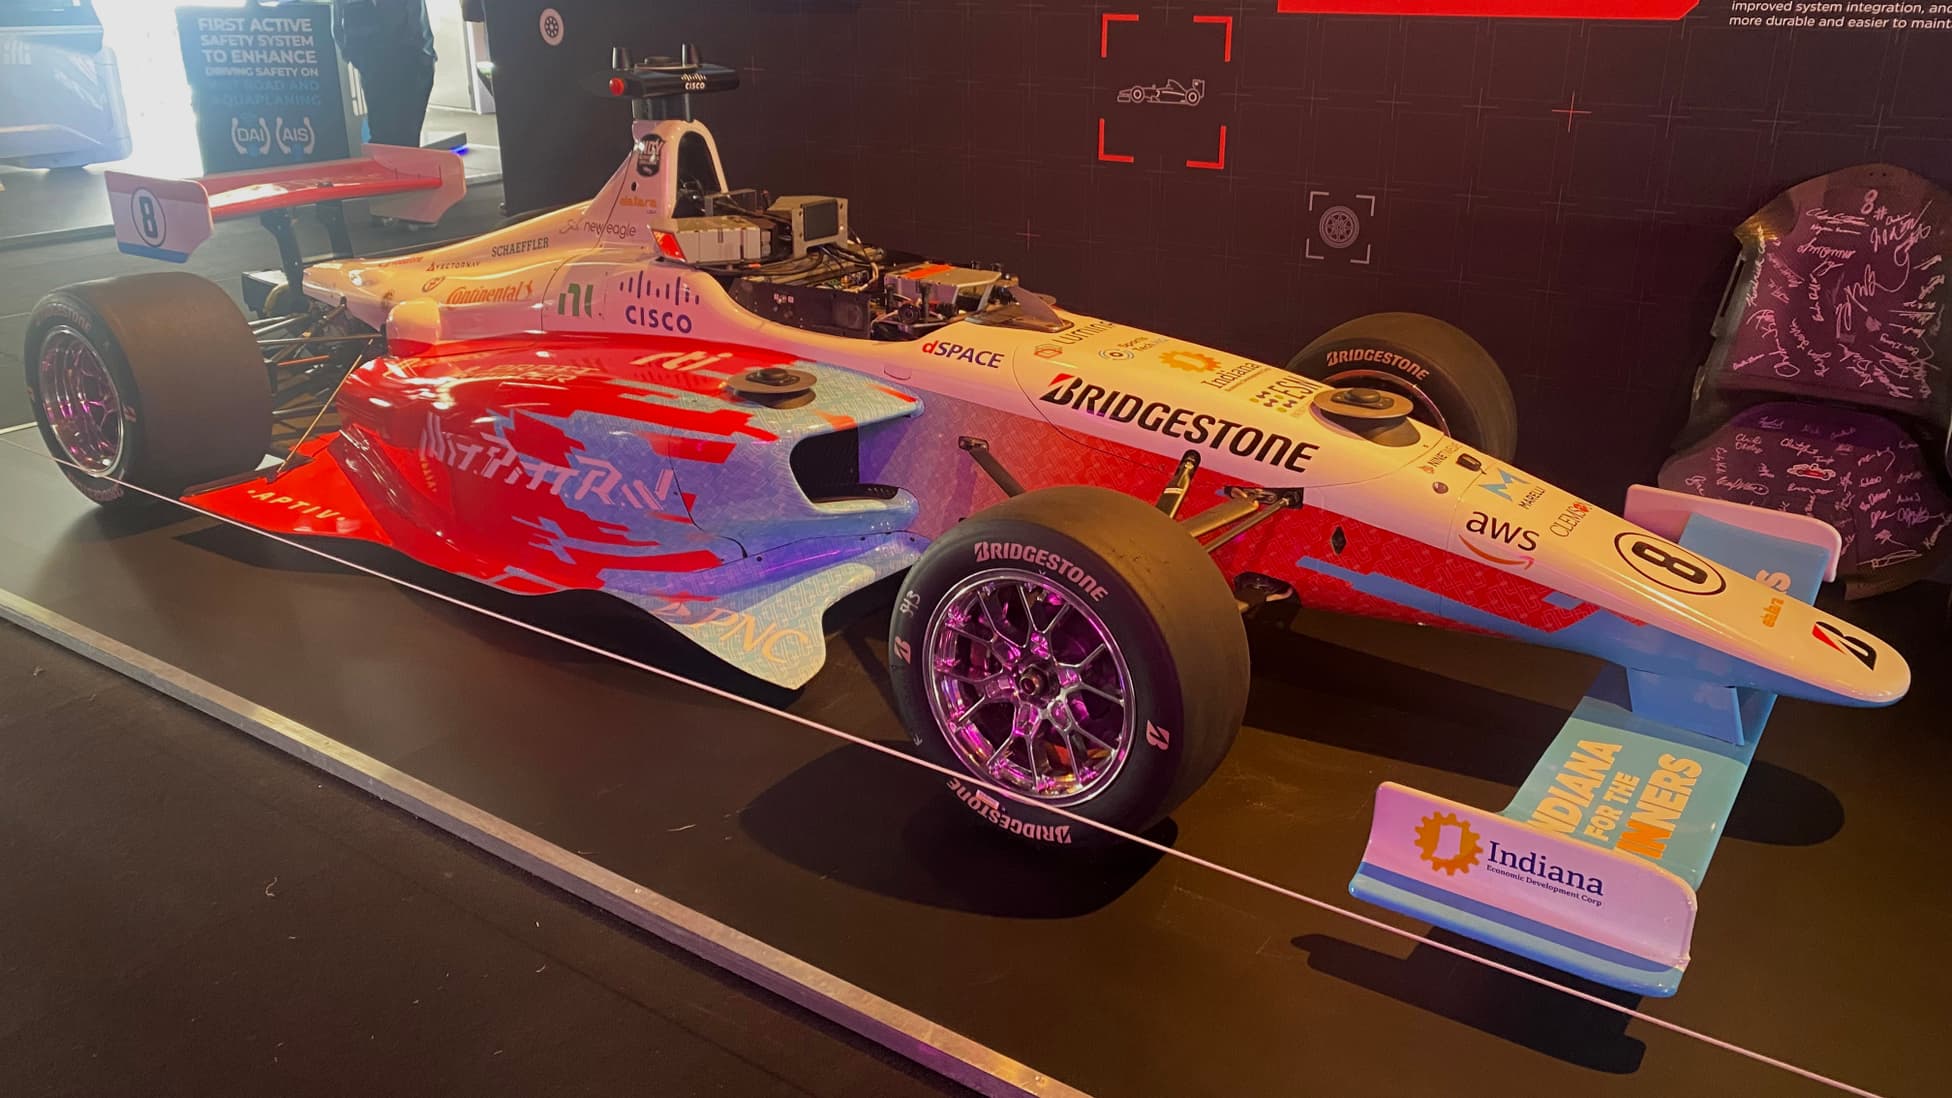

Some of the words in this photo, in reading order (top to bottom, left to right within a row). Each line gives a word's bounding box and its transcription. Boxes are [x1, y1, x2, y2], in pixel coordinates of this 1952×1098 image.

[1729, 16, 1762, 26] more
[1766, 15, 1815, 26] durable
[1818, 16, 1845, 27] and
[1847, 17, 1889, 28] easier
[1893, 18, 1907, 28] to
[1731, 0, 1793, 13] improved
[1795, 1, 1843, 14] system
[1846, 2, 1925, 15] integration,
[198, 18, 245, 32] FIRST
[250, 18, 313, 32] ACTIVE
[201, 34, 254, 47] SAFETY
[259, 35, 314, 47] SYSTEM
[202, 49, 228, 63] TO
[231, 49, 318, 64] ENHANCE
[256, 67, 298, 77] SAFETY
[301, 67, 319, 77] ON
[685, 81, 705, 90] CISCO
[237, 127, 265, 142] DAI
[283, 127, 309, 142] AIS
[138, 196, 159, 239] 8
[491, 236, 549, 258] SCHAEFFLER
[445, 280, 524, 308] Continental
[625, 305, 692, 334] CISCO
[921, 339, 1004, 369] dSPACE
[1326, 349, 1430, 381] BRIDGESTONE
[1201, 361, 1260, 389] Indiana
[1039, 372, 1321, 473] BRIDGESTONE
[1466, 510, 1540, 552] aws
[974, 541, 1109, 602] BRIDGESTONE
[1631, 541, 1709, 585] 8
[689, 607, 809, 664] PNC
[1603, 771, 1640, 804] THE
[946, 778, 1073, 844] BRIDGESTONE
[1584, 805, 1623, 842] FOR
[1487, 840, 1604, 896] Indiana
[1486, 864, 1525, 882] Economic
[1526, 876, 1580, 898] Development
[1581, 894, 1603, 907] Corp
